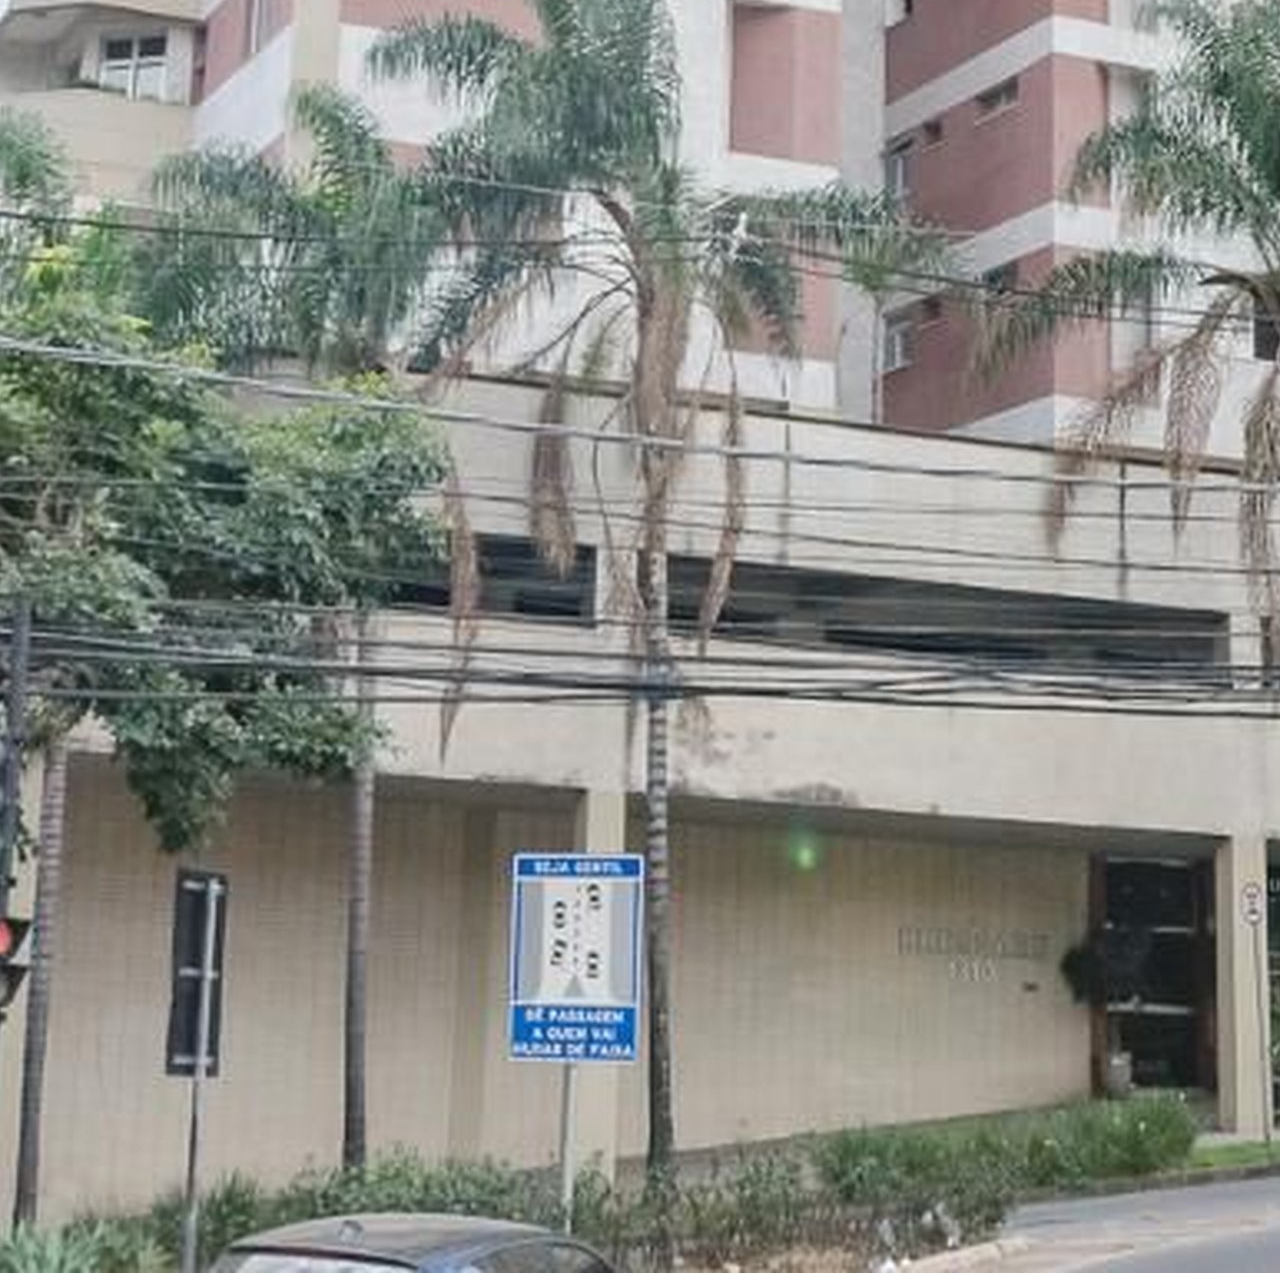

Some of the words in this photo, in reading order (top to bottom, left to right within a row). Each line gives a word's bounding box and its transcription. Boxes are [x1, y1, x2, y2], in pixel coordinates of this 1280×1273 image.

[534, 861, 570, 873] SEJA
[548, 1009, 624, 1023] PASSAGEM
[546, 1027, 587, 1040] QUEM
[588, 1043, 632, 1056] FAIXA
